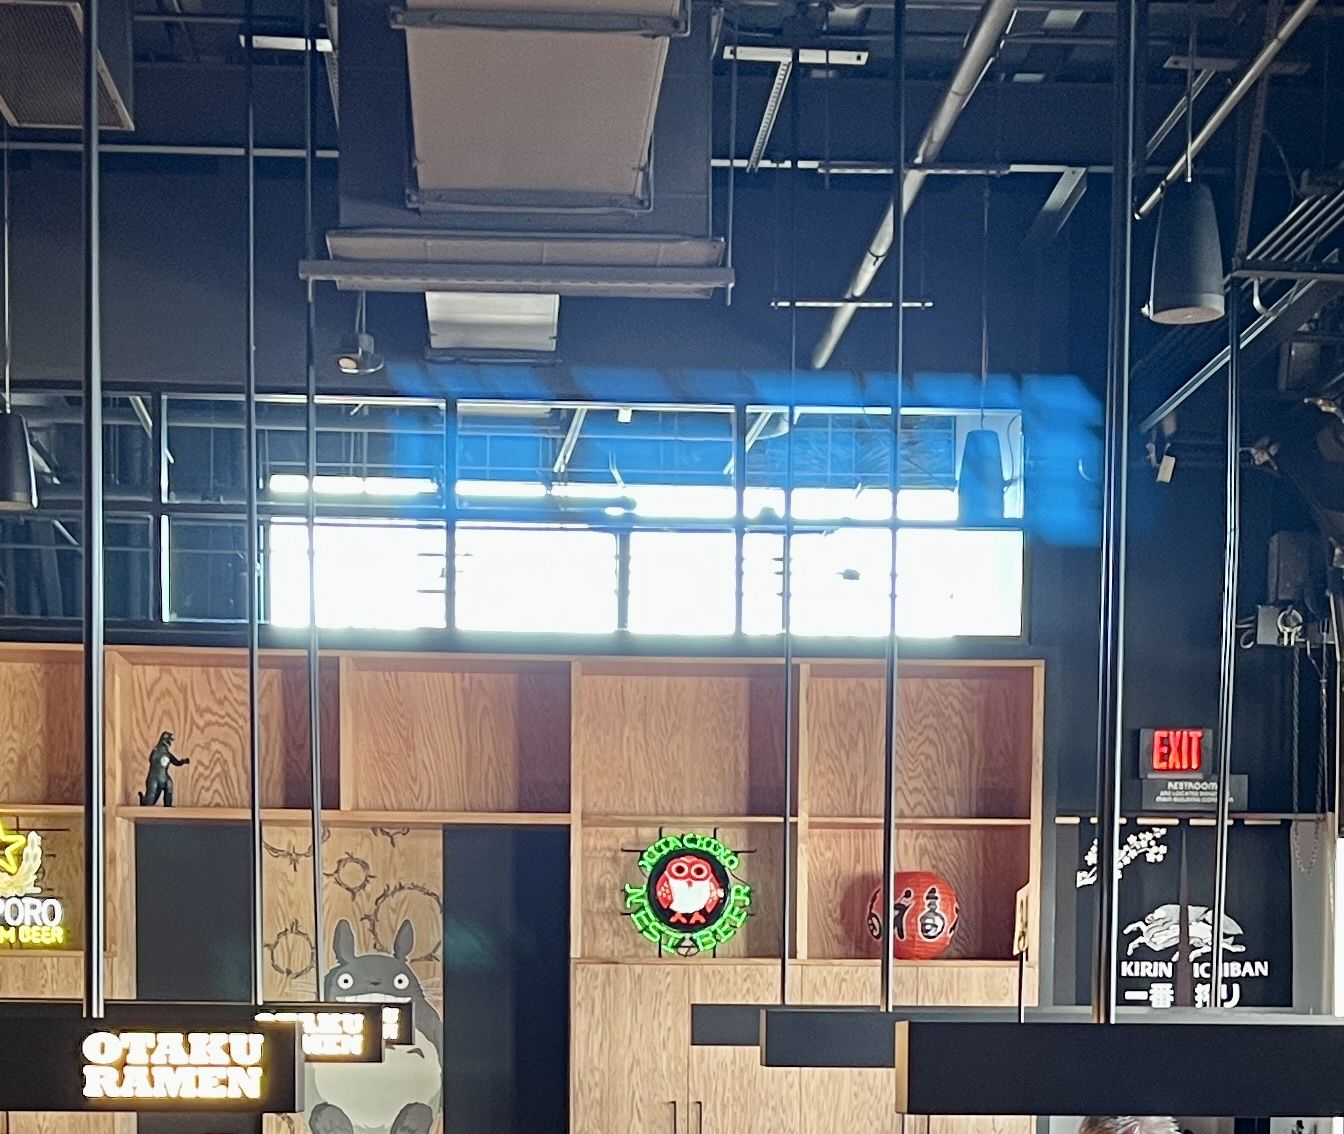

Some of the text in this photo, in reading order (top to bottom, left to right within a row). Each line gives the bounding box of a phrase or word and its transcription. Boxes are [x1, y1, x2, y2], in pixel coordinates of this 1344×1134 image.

[1153, 730, 1203, 770] EXIT
[1167, 781, 1217, 790] RESTROOM
[624, 883, 751, 953] NEST BEER
[1121, 961, 1269, 978] KIRIN ICIBAN
[82, 1031, 264, 1065] OTAKU
[82, 1064, 263, 1099] RAMEN
